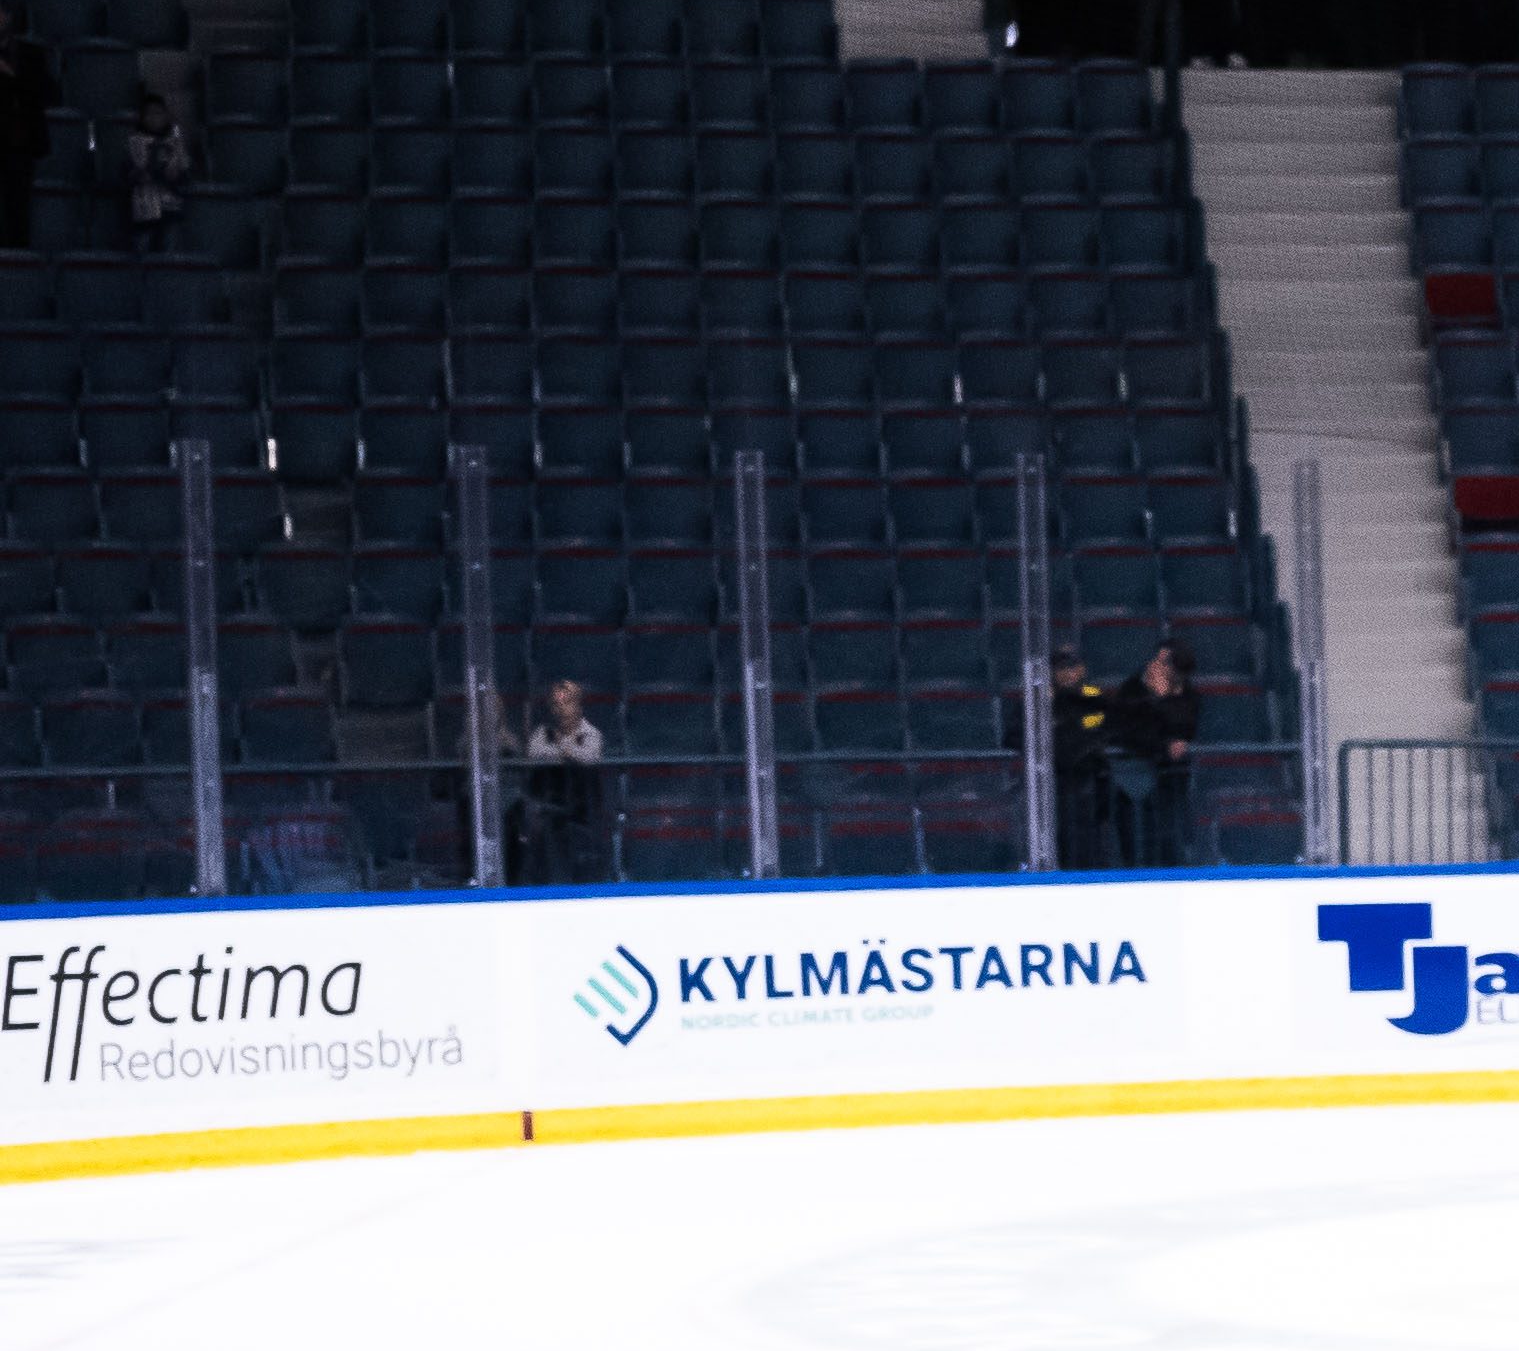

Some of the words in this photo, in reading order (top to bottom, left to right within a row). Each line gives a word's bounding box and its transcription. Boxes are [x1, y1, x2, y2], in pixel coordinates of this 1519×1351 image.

[678, 939, 1148, 1003] KYLMÄSTARNA
[2, 944, 362, 1082] Effectima
[680, 1011, 759, 1031] NORDIC
[767, 1007, 856, 1027] CLIMATE
[861, 1004, 936, 1023] GROUP
[98, 1025, 465, 1081] Redovisningsbyrå
